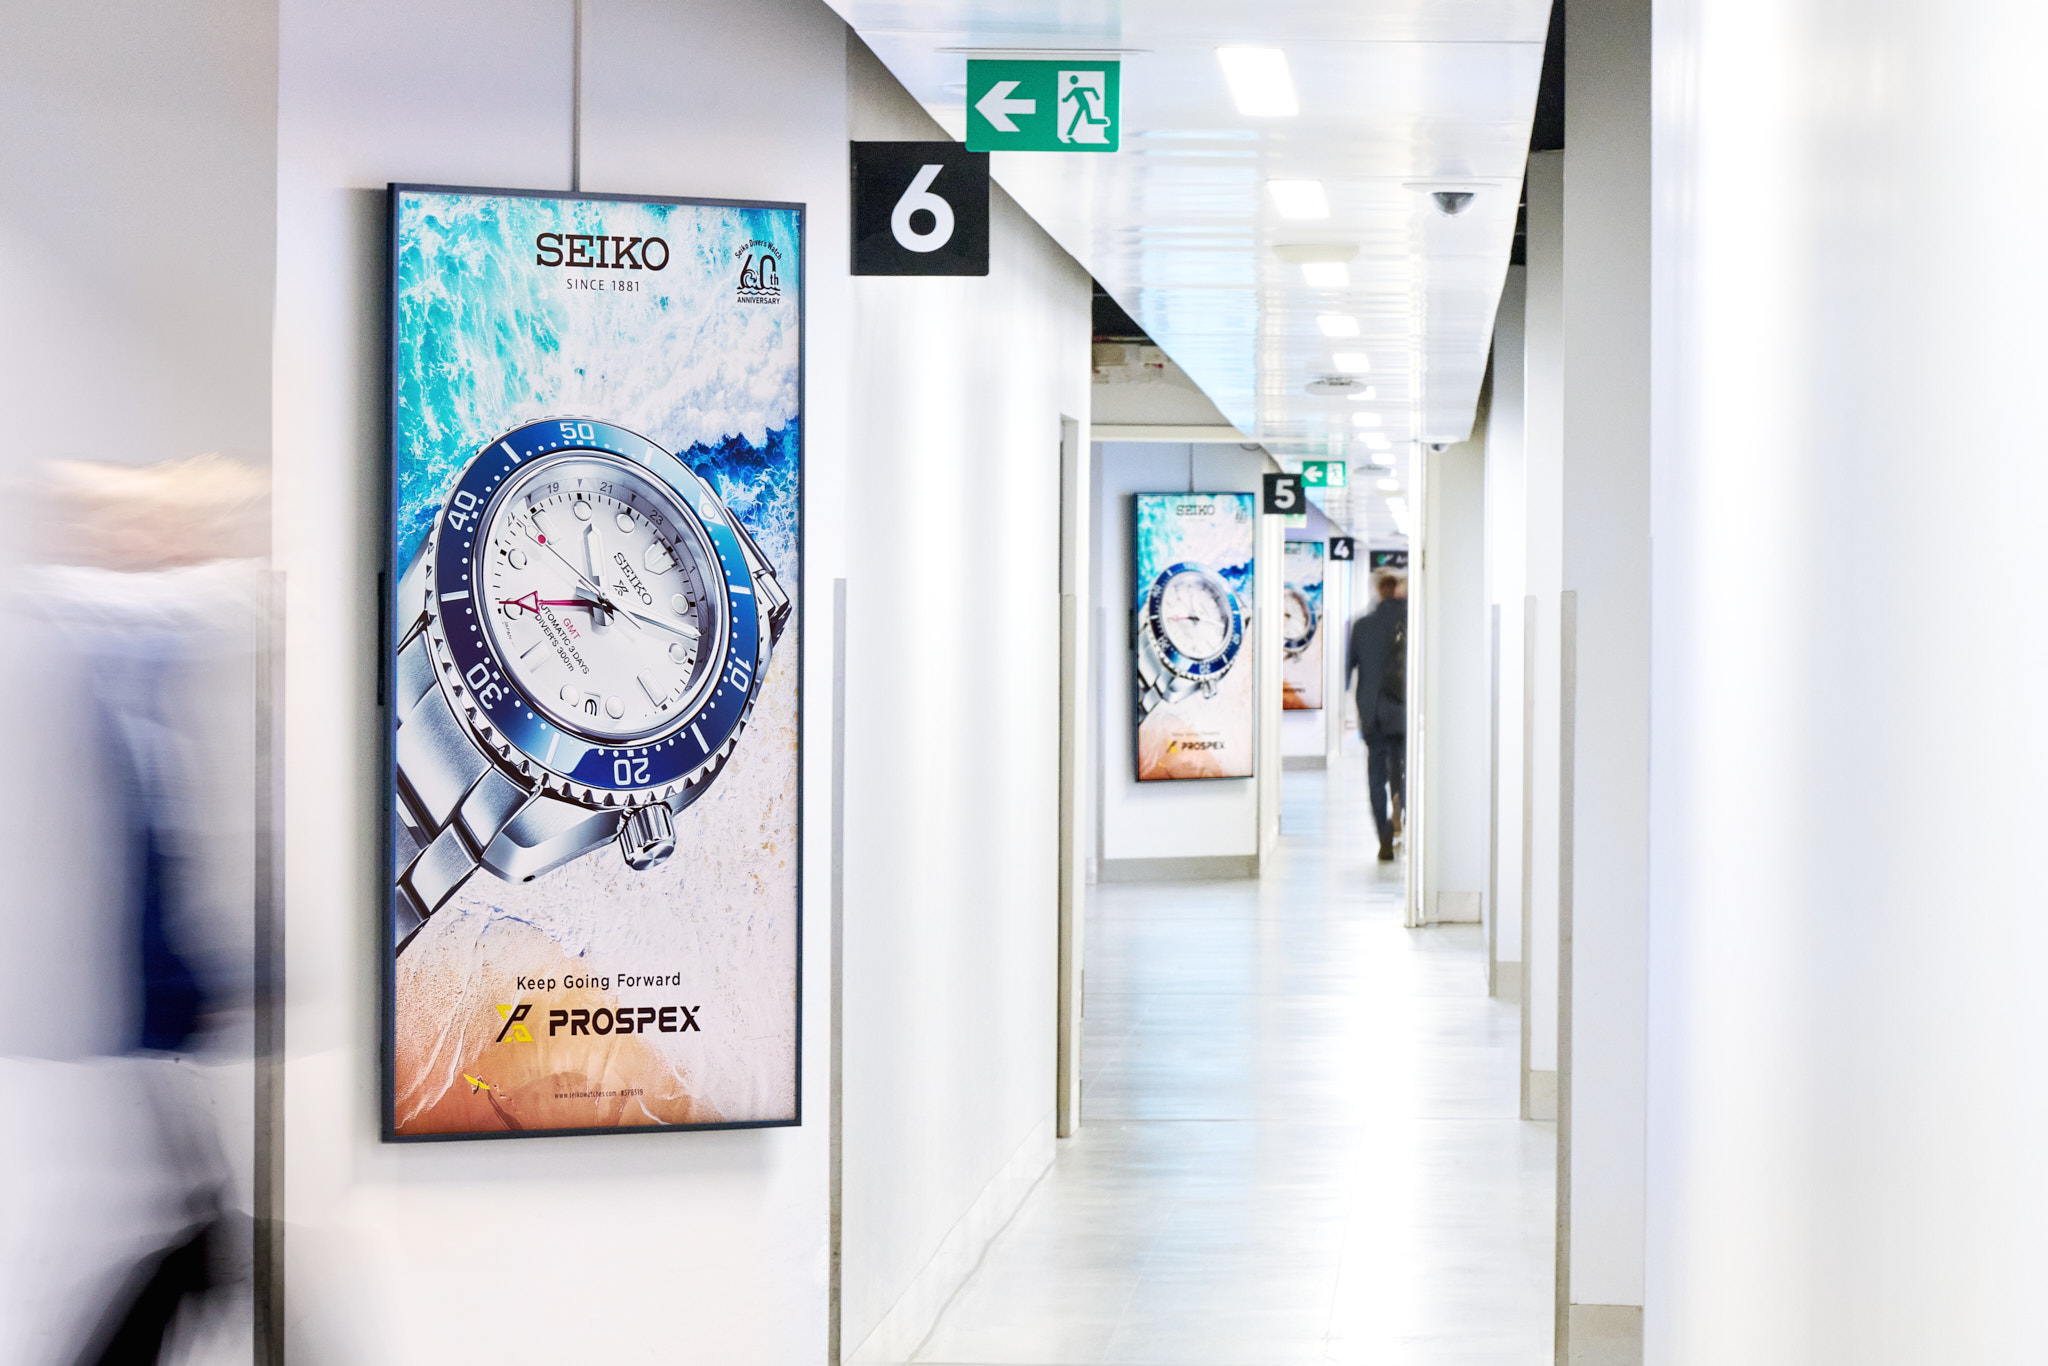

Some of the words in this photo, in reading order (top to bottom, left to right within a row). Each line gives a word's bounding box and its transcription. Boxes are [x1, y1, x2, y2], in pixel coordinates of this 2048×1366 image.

[891, 164, 955, 253] 6
[536, 232, 670, 271] SEIKO
[734, 243, 749, 259] Seiko
[749, 239, 767, 248] Diver's
[767, 241, 782, 260] Watch
[567, 278, 605, 291] SINCE
[611, 280, 640, 292] 1881
[736, 296, 780, 304] ANNIVERSARY
[560, 422, 595, 440] 50
[546, 482, 559, 494] 19
[599, 481, 614, 493] 21
[1274, 479, 1296, 509] 5
[447, 490, 477, 531] 40
[650, 509, 664, 525] 23
[1175, 504, 1216, 516] SEIKO
[1333, 539, 1350, 559] 4
[613, 552, 653, 606] SEIKO
[539, 600, 571, 647] UTOMATIC
[568, 645, 576, 653] 3
[572, 651, 590, 675] DAYS
[563, 617, 581, 640] GMT
[534, 613, 559, 647] DIVER'S
[556, 646, 575, 672] 300m
[729, 657, 752, 693] 10
[465, 662, 503, 711] 30
[1181, 741, 1225, 751] PROSPEX
[613, 756, 651, 786] 20
[517, 976, 556, 992] Keep
[563, 974, 610, 991] Going
[617, 972, 681, 988] Forward
[549, 1005, 701, 1037] PROSPEX
[554, 1089, 617, 1099] www.seikowatches.com
